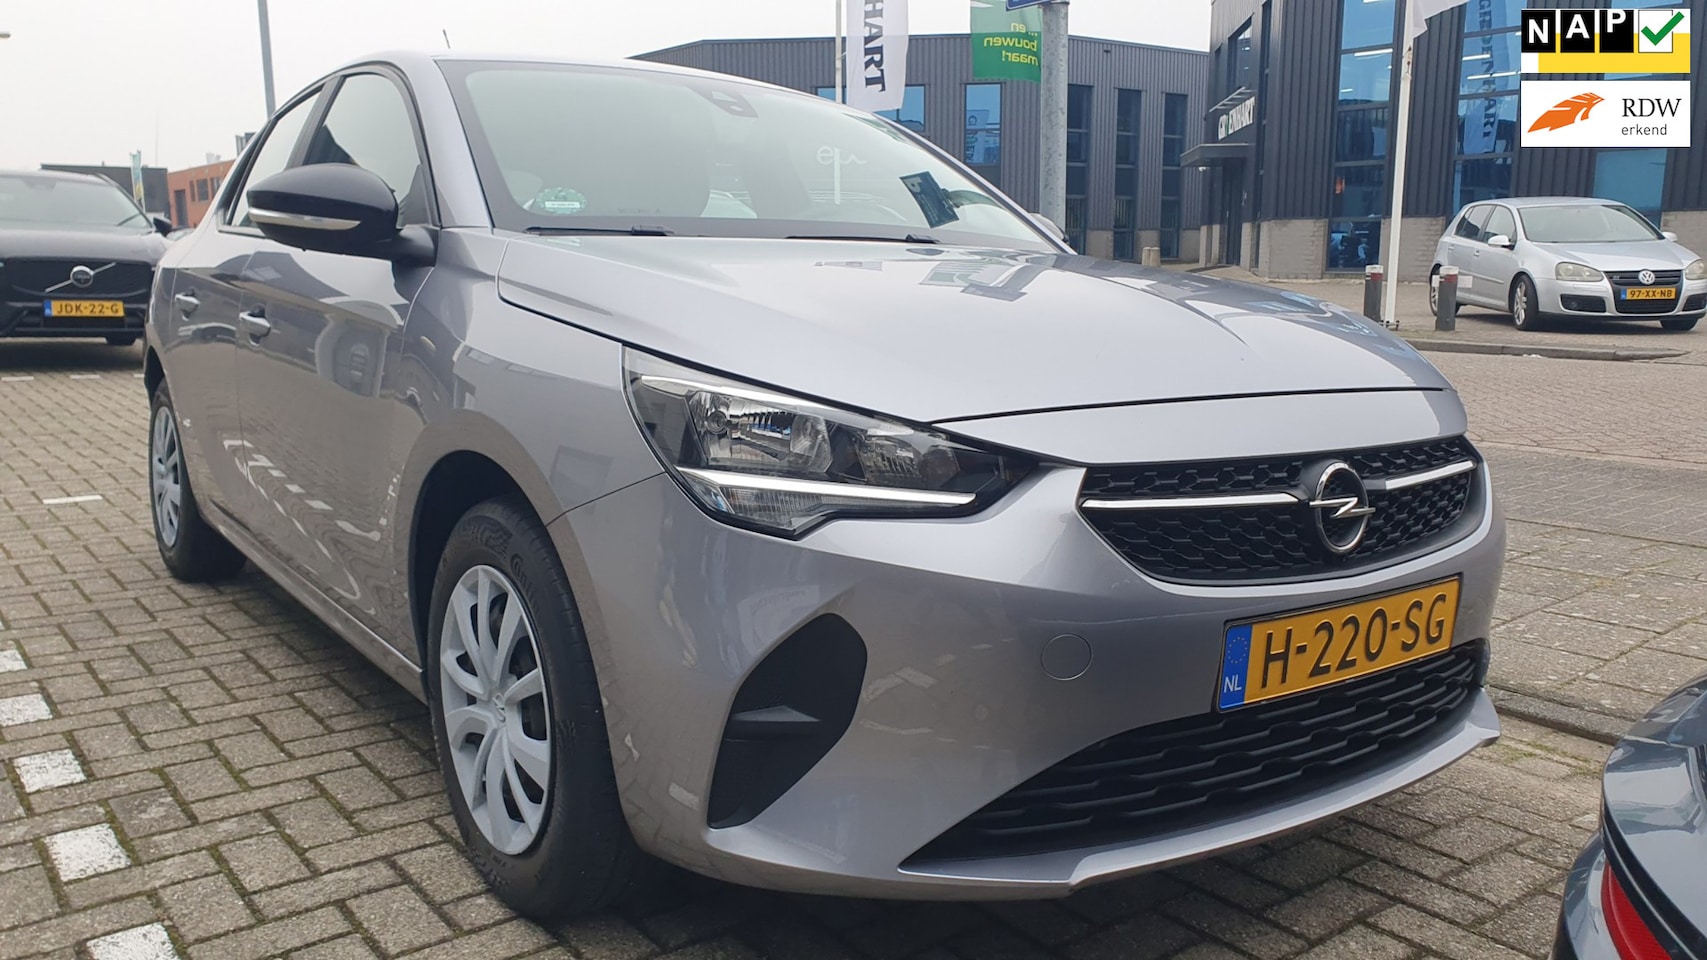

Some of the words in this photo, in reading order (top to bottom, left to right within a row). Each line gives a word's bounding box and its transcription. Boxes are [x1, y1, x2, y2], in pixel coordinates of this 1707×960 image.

[1629, 289, 1673, 298] 97-XX-NB
[57, 303, 119, 314] JDK-22-G
[1261, 593, 1447, 689] H-220-SG
[1223, 674, 1242, 693] NL
